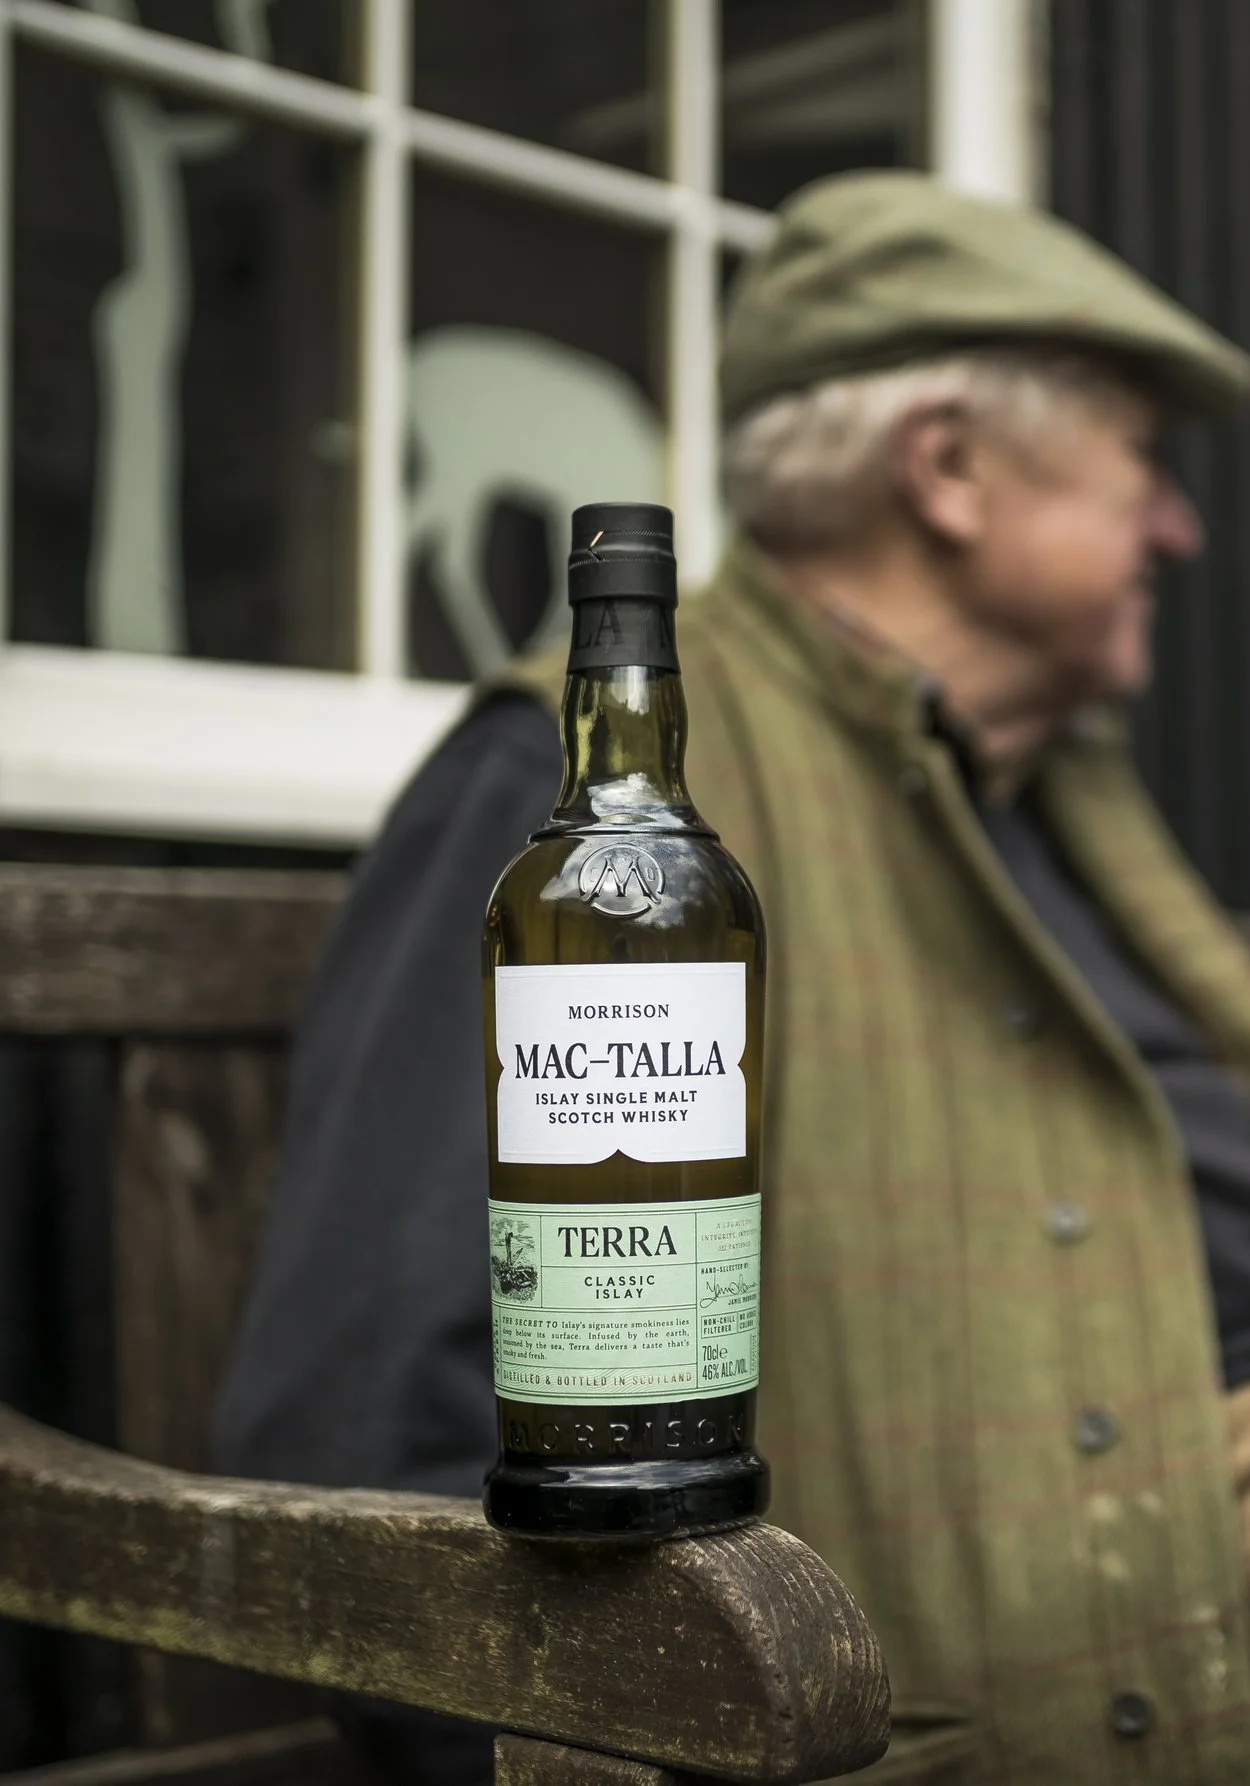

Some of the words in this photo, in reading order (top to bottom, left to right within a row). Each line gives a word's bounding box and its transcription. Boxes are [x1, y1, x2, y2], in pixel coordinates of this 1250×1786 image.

[568, 1004, 670, 1020] MORRISON
[535, 1093, 579, 1105] ISLAY
[586, 1092, 648, 1104] SINGLE
[654, 1090, 698, 1103] MALT
[548, 1111, 614, 1124] SCOTCH
[622, 1109, 688, 1123] WHISKY
[558, 1225, 677, 1257] TERRA
[701, 1263, 743, 1275] HAND-SELECTED
[584, 1275, 656, 1287] CLASSIC
[596, 1288, 644, 1299] ISLAY
[502, 1316, 513, 1325] THE
[515, 1319, 544, 1328] SECRET
[546, 1320, 558, 1329] TO
[561, 1321, 586, 1331] Islay's
[588, 1322, 628, 1331] signature
[630, 1320, 674, 1328] smokiness
[676, 1318, 690, 1327] lies
[703, 1315, 736, 1326] NON-CHILL
[515, 1329, 532, 1337] below
[536, 1331, 546, 1339] its
[551, 1332, 581, 1340] surface.
[588, 1331, 621, 1340] Infused
[627, 1331, 638, 1341] by
[645, 1330, 659, 1338] the
[665, 1328, 690, 1337] earth,
[703, 1325, 732, 1335] FILTERED
[525, 1340, 534, 1350] by
[536, 1340, 547, 1349] the
[569, 1342, 590, 1351] Terra
[594, 1342, 628, 1351] delivers
[642, 1342, 663, 1350] taste
[667, 1339, 690, 1348] that's
[517, 1350, 528, 1359] and
[528, 1351, 548, 1360] fresh.
[503, 1369, 540, 1385] DISTILLED
[545, 1375, 552, 1385] &
[557, 1376, 607, 1387] BOTTLED
[614, 1375, 626, 1386] IN
[632, 1372, 692, 1386] SCOTLAND
[702, 1363, 719, 1380] 46%
[508, 1413, 744, 1453] MORRISON
